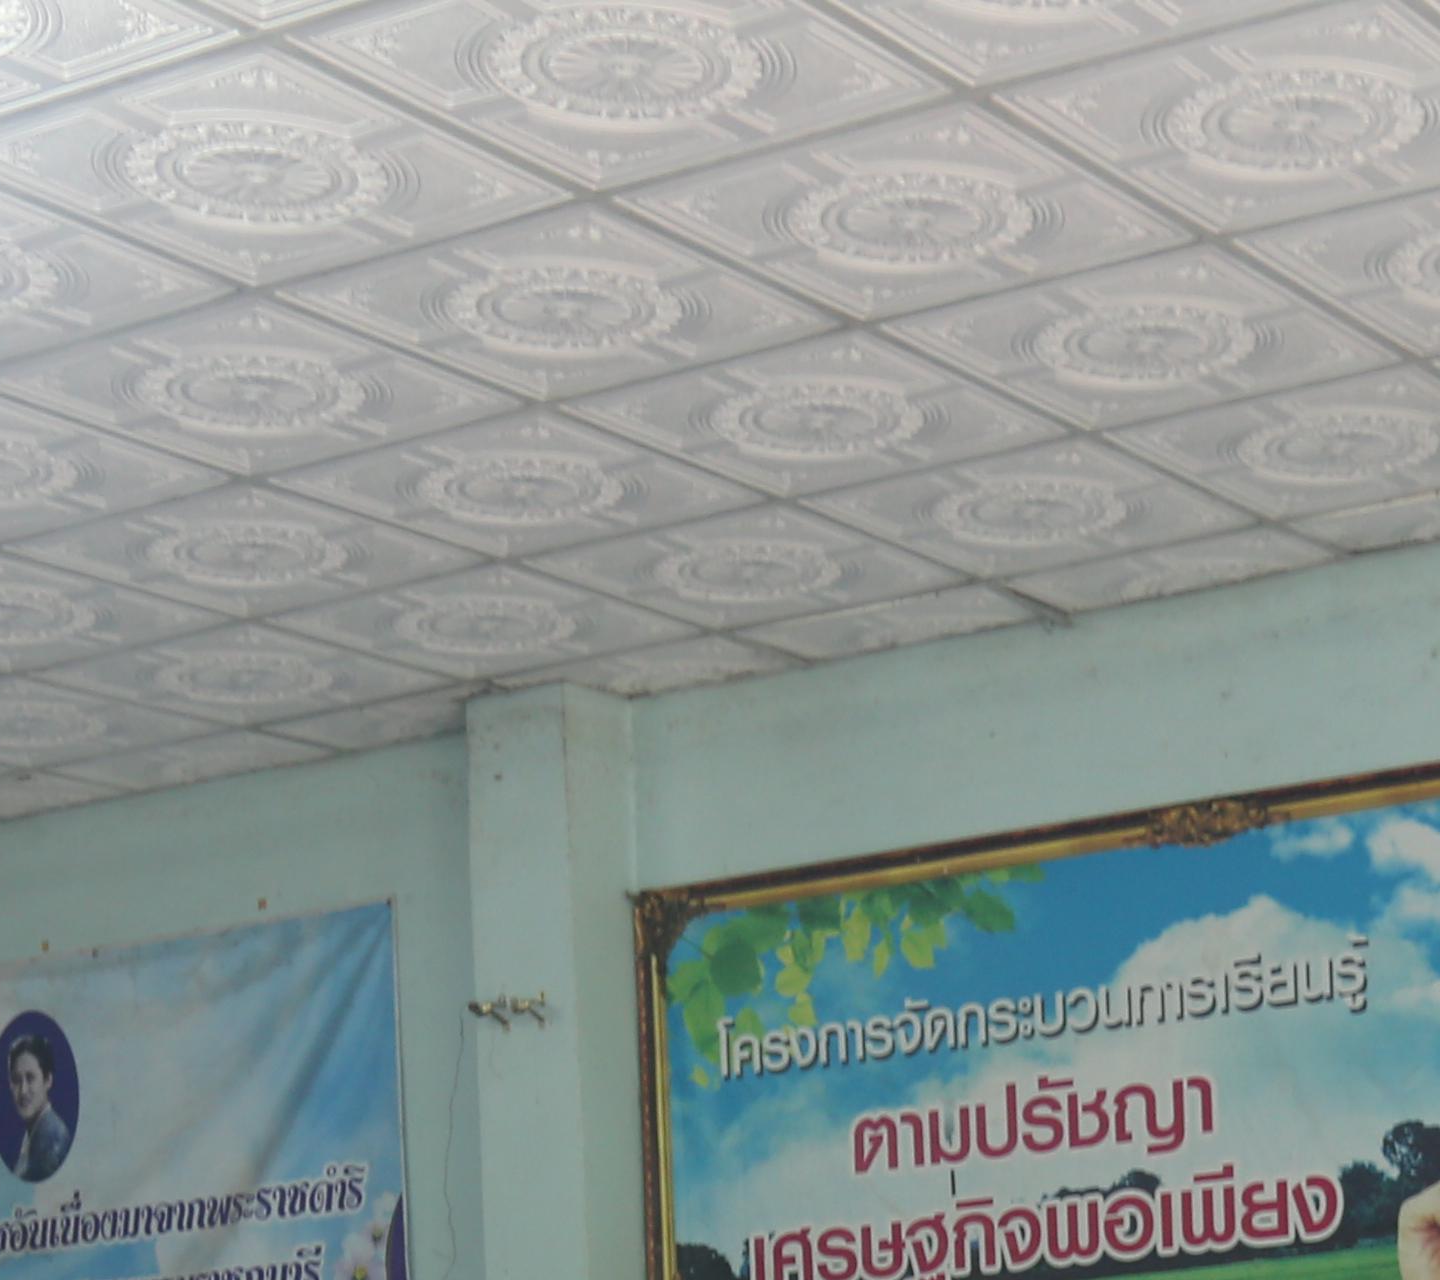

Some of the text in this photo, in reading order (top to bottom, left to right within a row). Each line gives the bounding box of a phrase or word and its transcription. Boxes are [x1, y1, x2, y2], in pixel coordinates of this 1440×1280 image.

[717, 936, 1370, 1080] โครงการจัดกระบวนการเรียนรู้
[851, 1073, 1216, 1175] ตามปรัชญา
